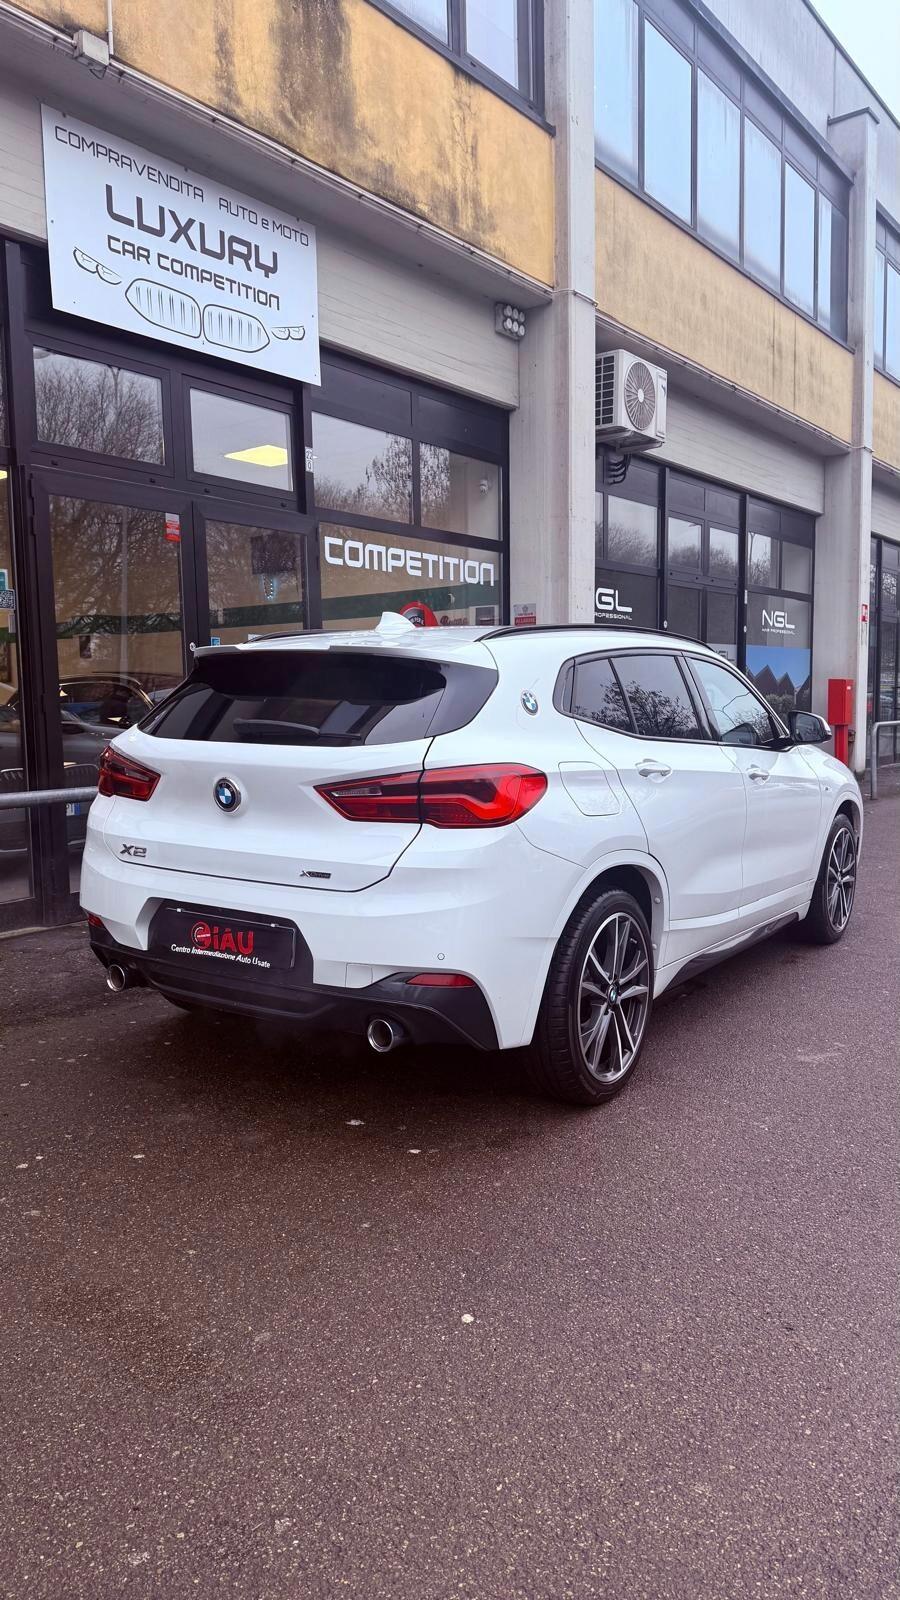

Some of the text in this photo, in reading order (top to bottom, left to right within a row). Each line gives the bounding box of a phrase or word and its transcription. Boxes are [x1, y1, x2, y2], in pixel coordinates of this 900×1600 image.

[55, 125, 204, 203] COMPRAVENDITA
[219, 197, 258, 225] AUTO
[273, 223, 309, 247] MOTO
[105, 183, 278, 279] LUXURY
[107, 234, 280, 311] CAR COMPETITION
[324, 536, 494, 587] COMPETITION
[595, 587, 632, 612] GL
[594, 612, 632, 620] ROFESSIONAL
[762, 609, 795, 629] NGL
[120, 844, 146, 857] X2
[170, 944, 191, 954] Centro
[236, 954, 251, 965] Auto
[252, 957, 271, 968] Usate
